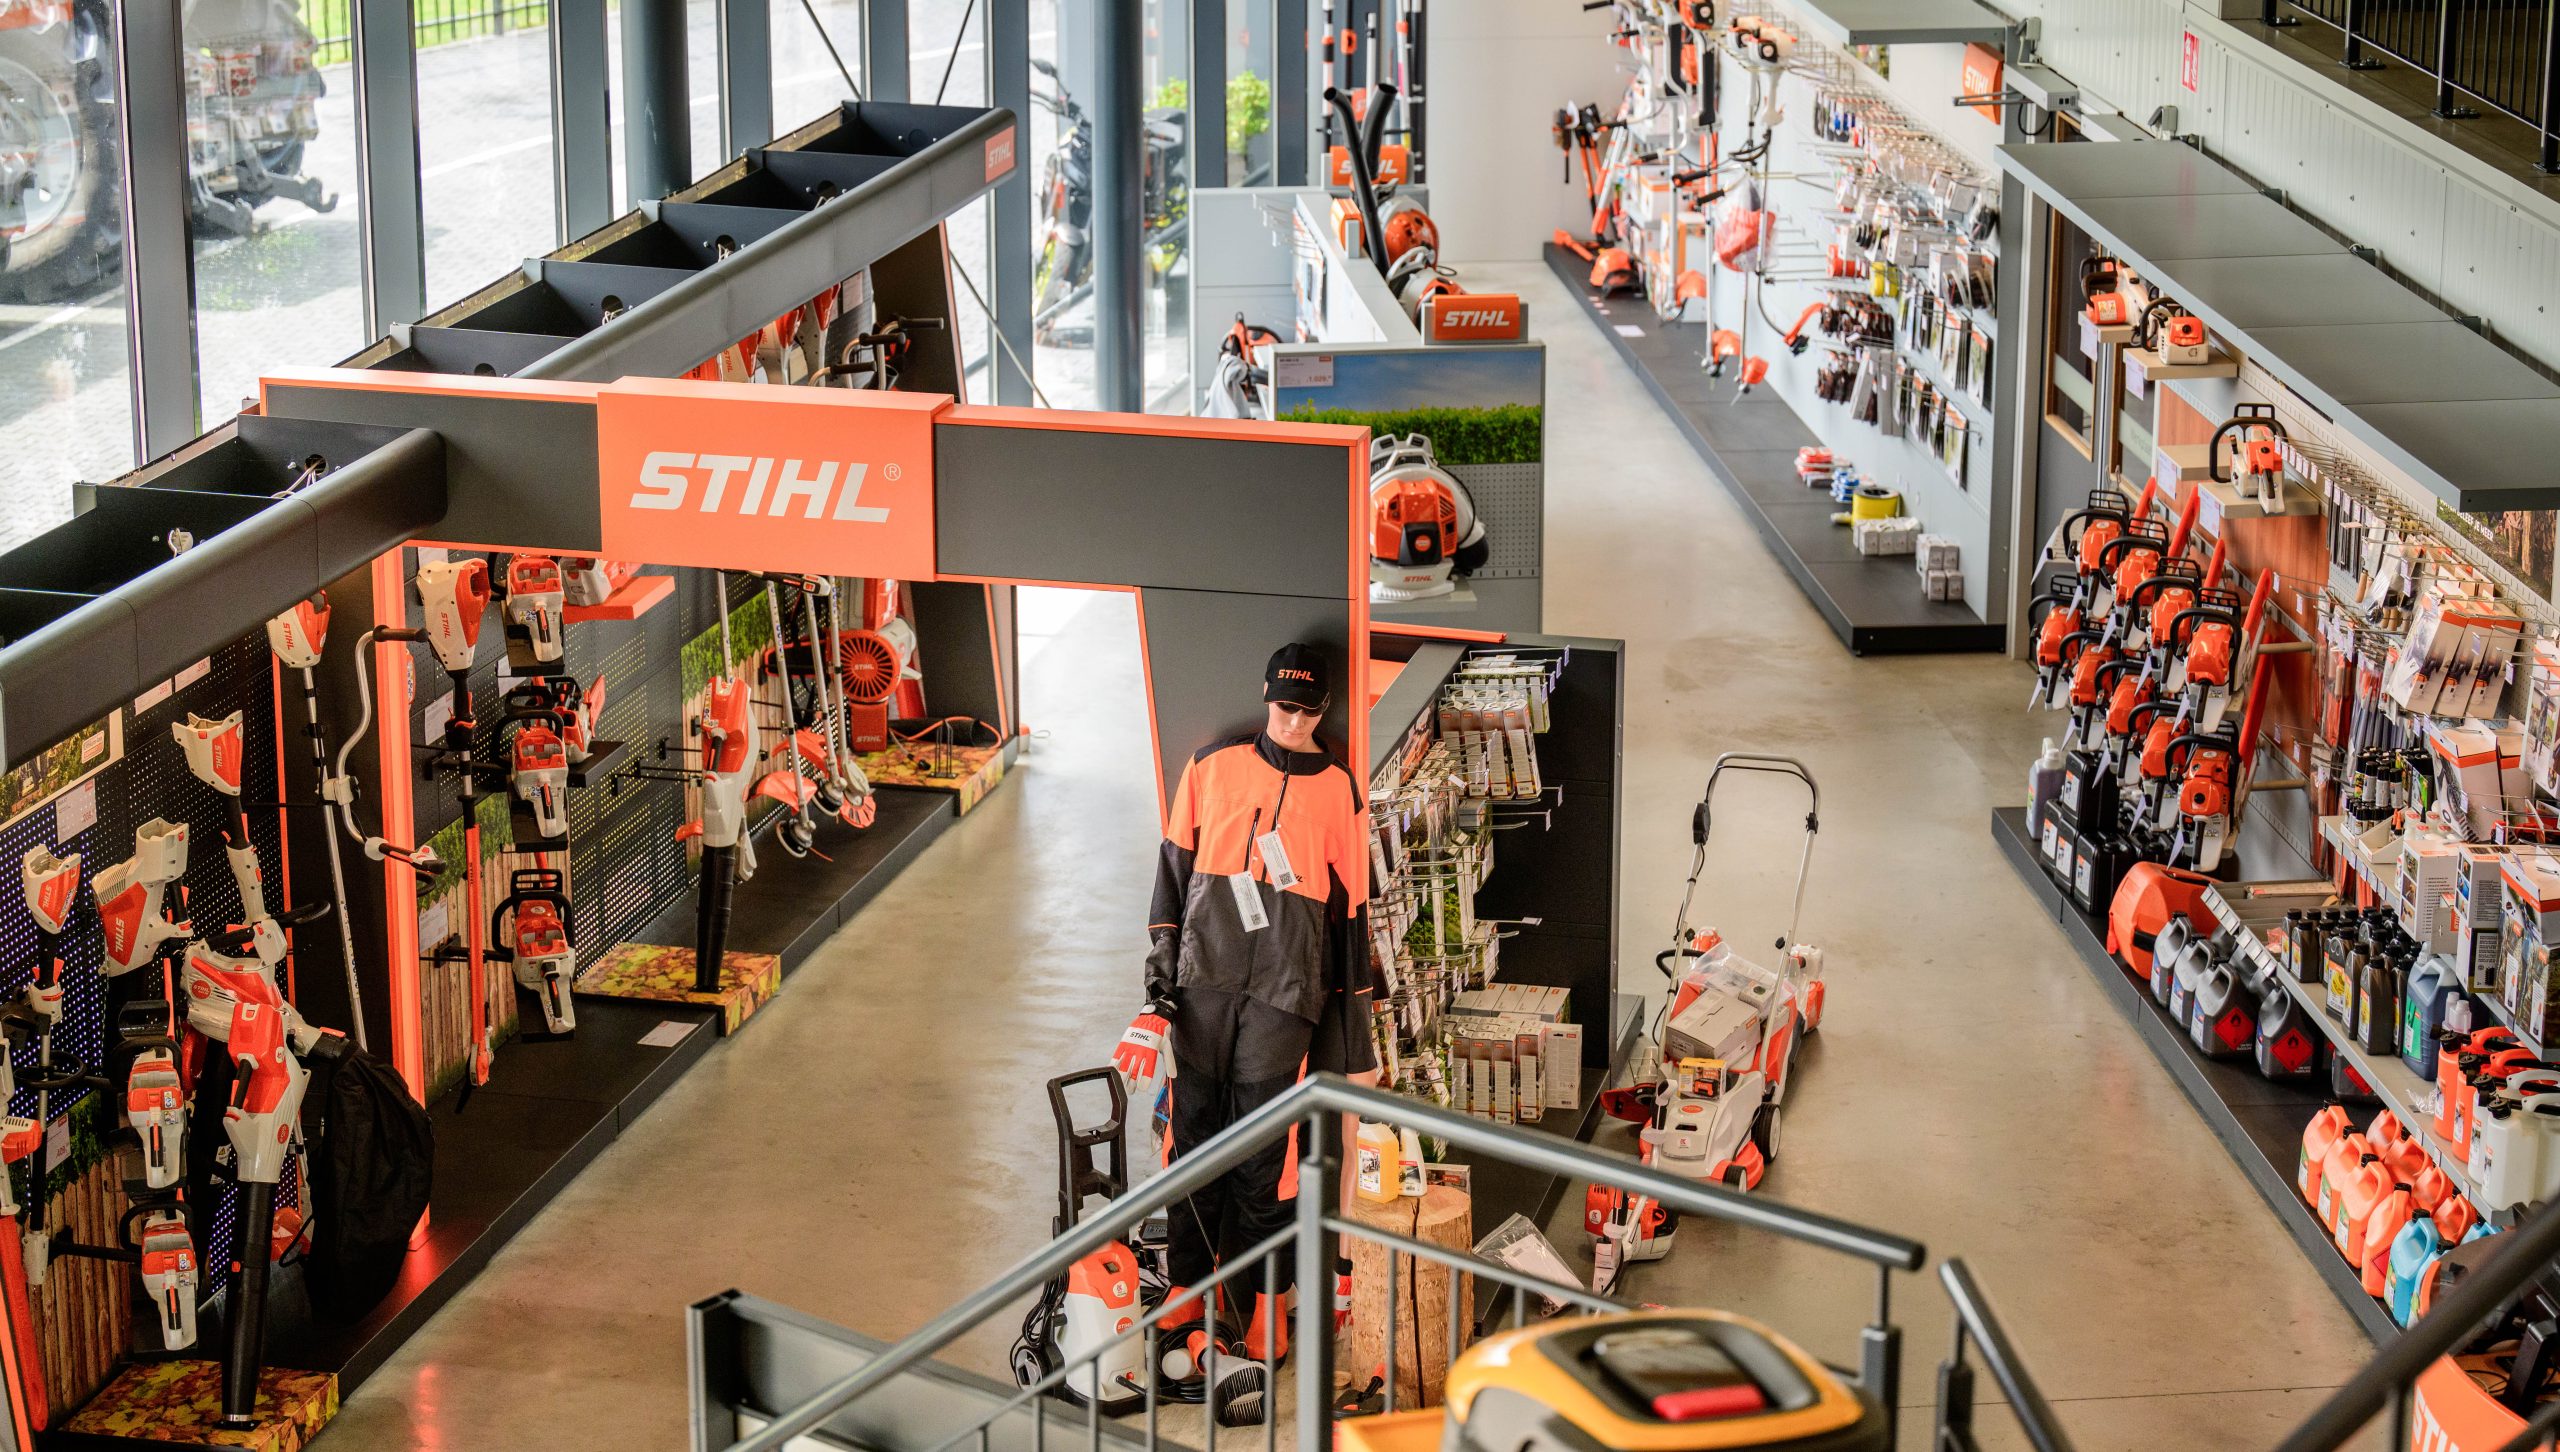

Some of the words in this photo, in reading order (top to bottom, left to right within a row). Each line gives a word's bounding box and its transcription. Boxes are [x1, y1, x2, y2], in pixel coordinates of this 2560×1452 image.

[988, 142, 1012, 169] STIHL
[1442, 309, 1510, 329] STIHL
[723, 350, 733, 373] STIHL
[1403, 575, 1433, 583] STIHL
[440, 611, 451, 639] STIHL
[283, 622, 296, 651] STIHL
[854, 663, 875, 671] STIHL
[1277, 669, 1315, 682] STIHL
[856, 735, 882, 744] STIHL
[214, 744, 223, 770] STIHL
[42, 885, 54, 910] STIHL
[115, 916, 126, 953] STIHL
[193, 984, 210, 993] STIHL
[1129, 1030, 1155, 1043] STIHL
[1117, 1320, 1133, 1332] STIHL
